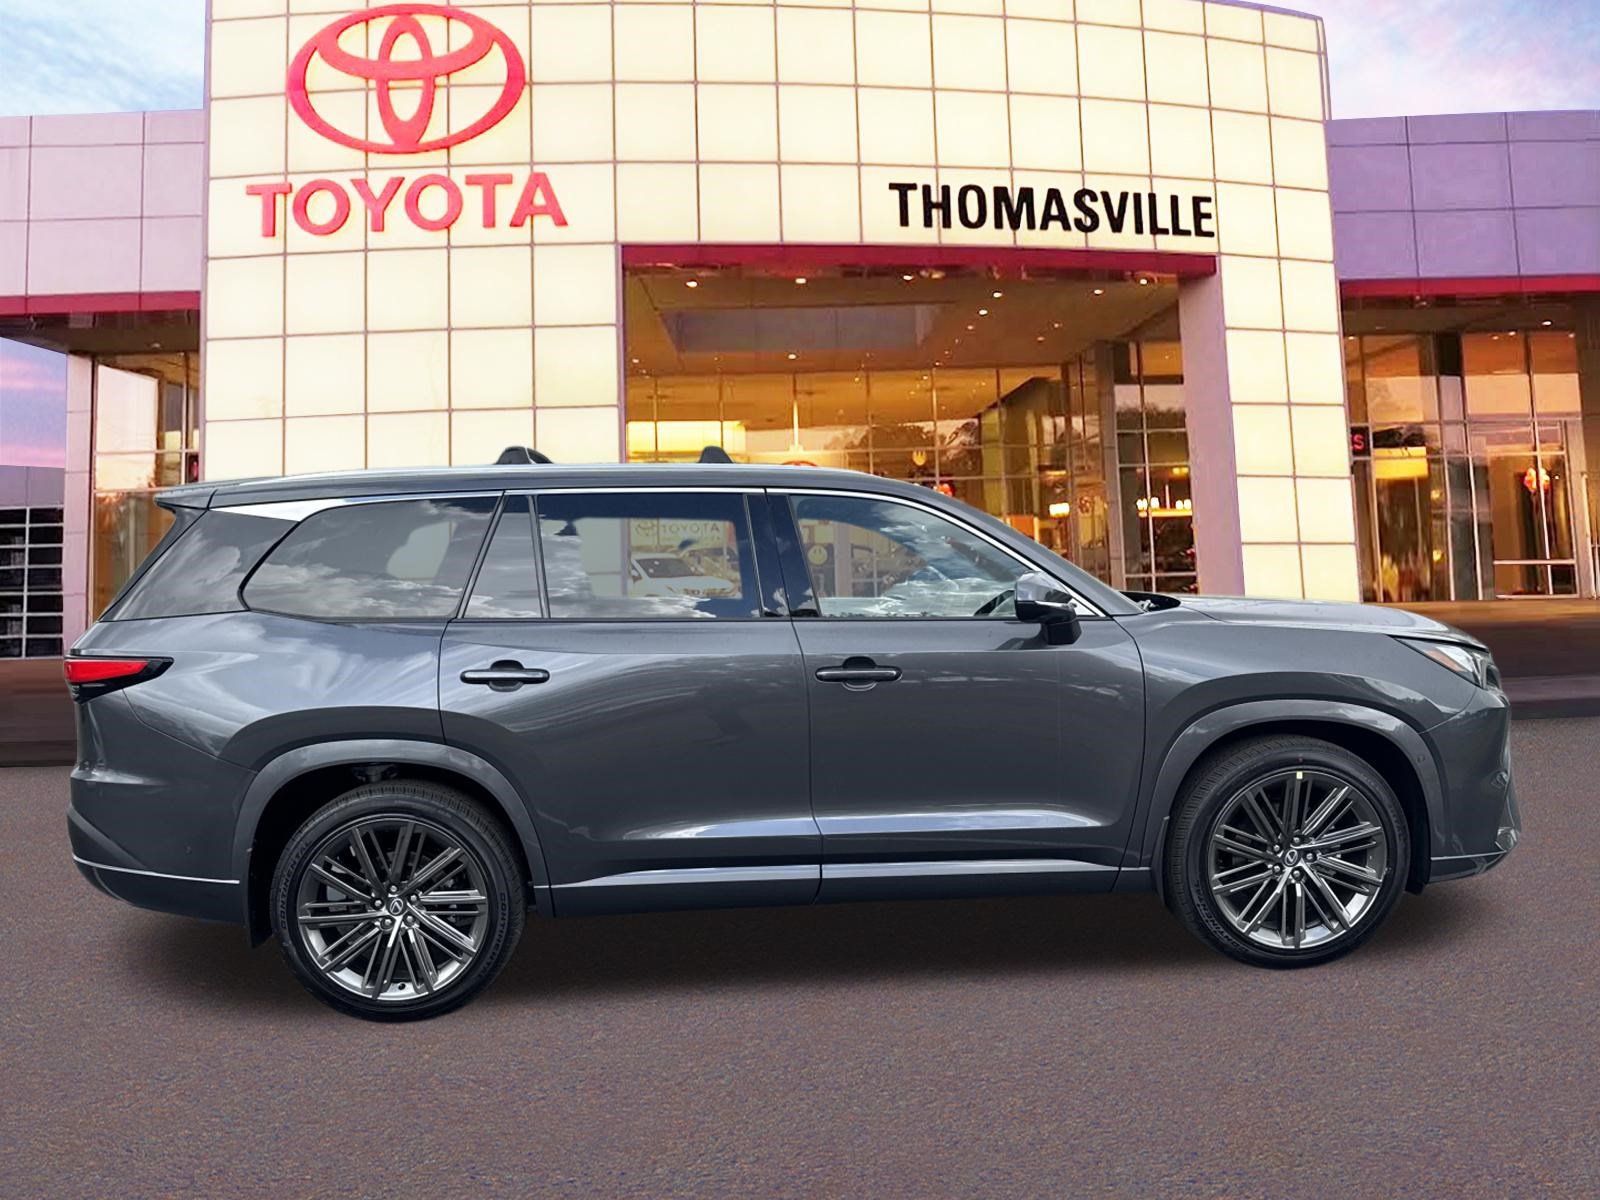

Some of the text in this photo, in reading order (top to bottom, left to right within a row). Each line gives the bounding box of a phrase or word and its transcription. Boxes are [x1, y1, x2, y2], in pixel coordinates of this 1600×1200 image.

[246, 172, 568, 238] TOYOTA
[889, 182, 1217, 238] THOMASVILLE
[661, 522, 720, 535] TOYOTA
